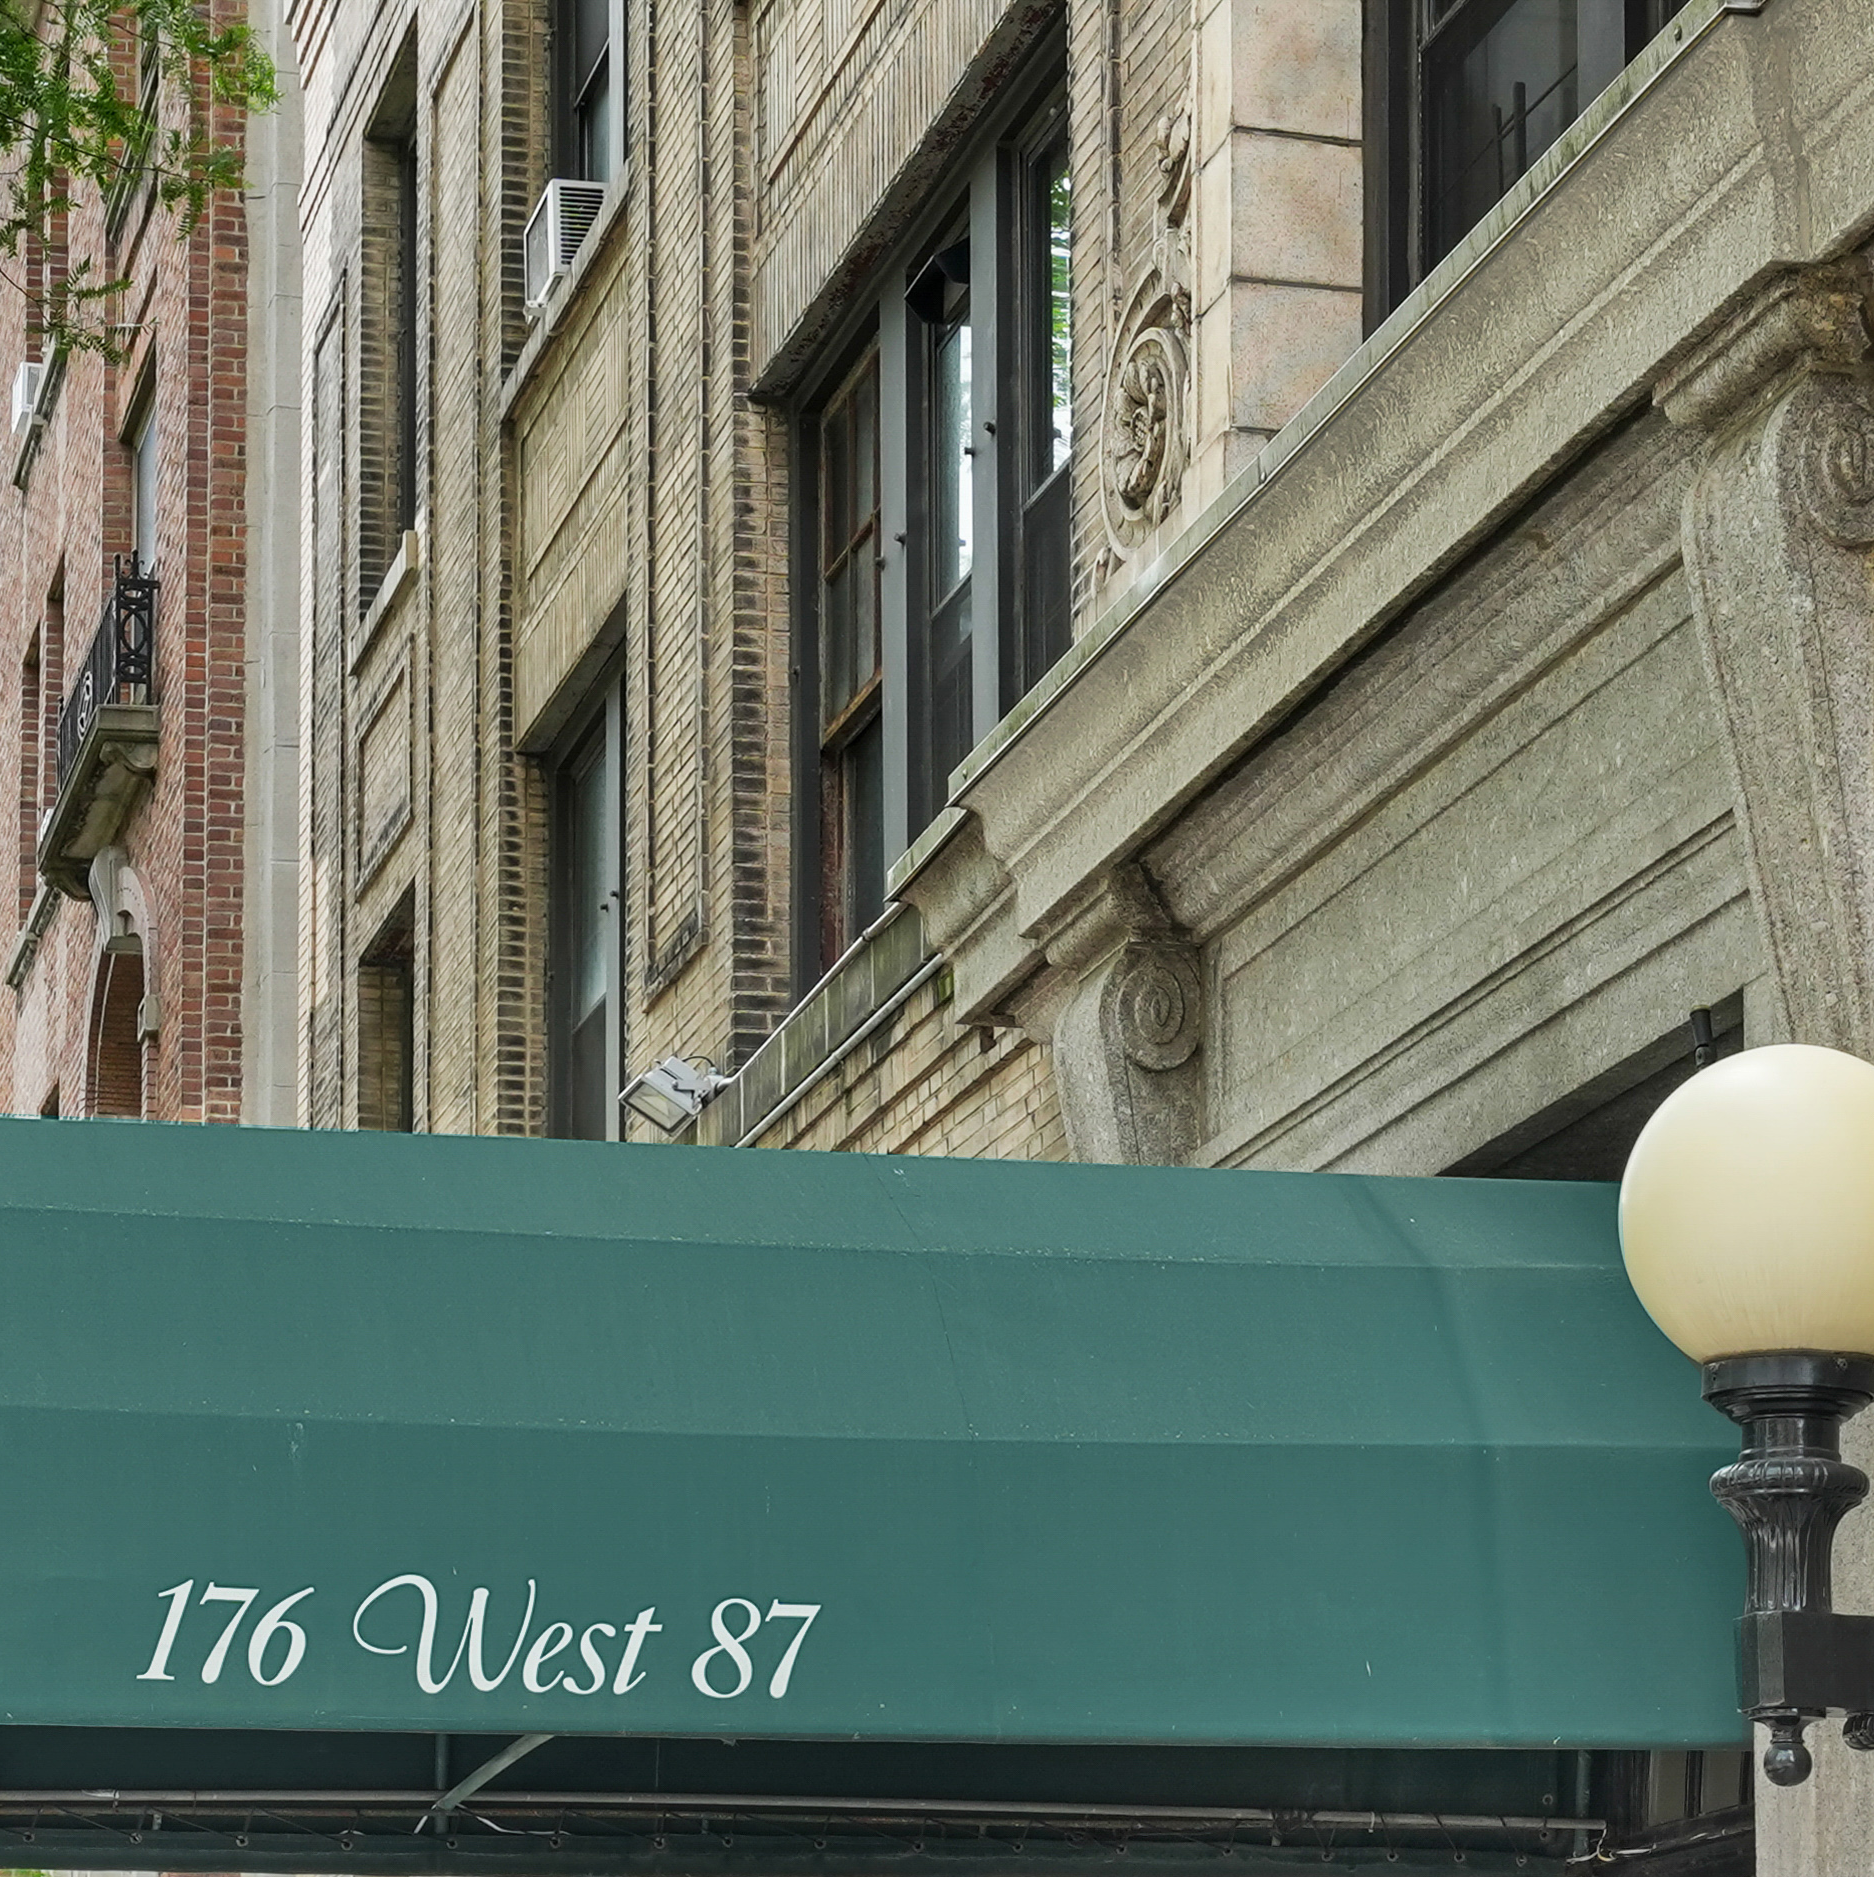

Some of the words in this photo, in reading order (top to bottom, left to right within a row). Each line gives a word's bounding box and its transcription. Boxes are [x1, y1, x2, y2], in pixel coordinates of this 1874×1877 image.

[135, 1578, 315, 1687] 176
[353, 1573, 663, 1695] West
[691, 1598, 822, 1699] 87
